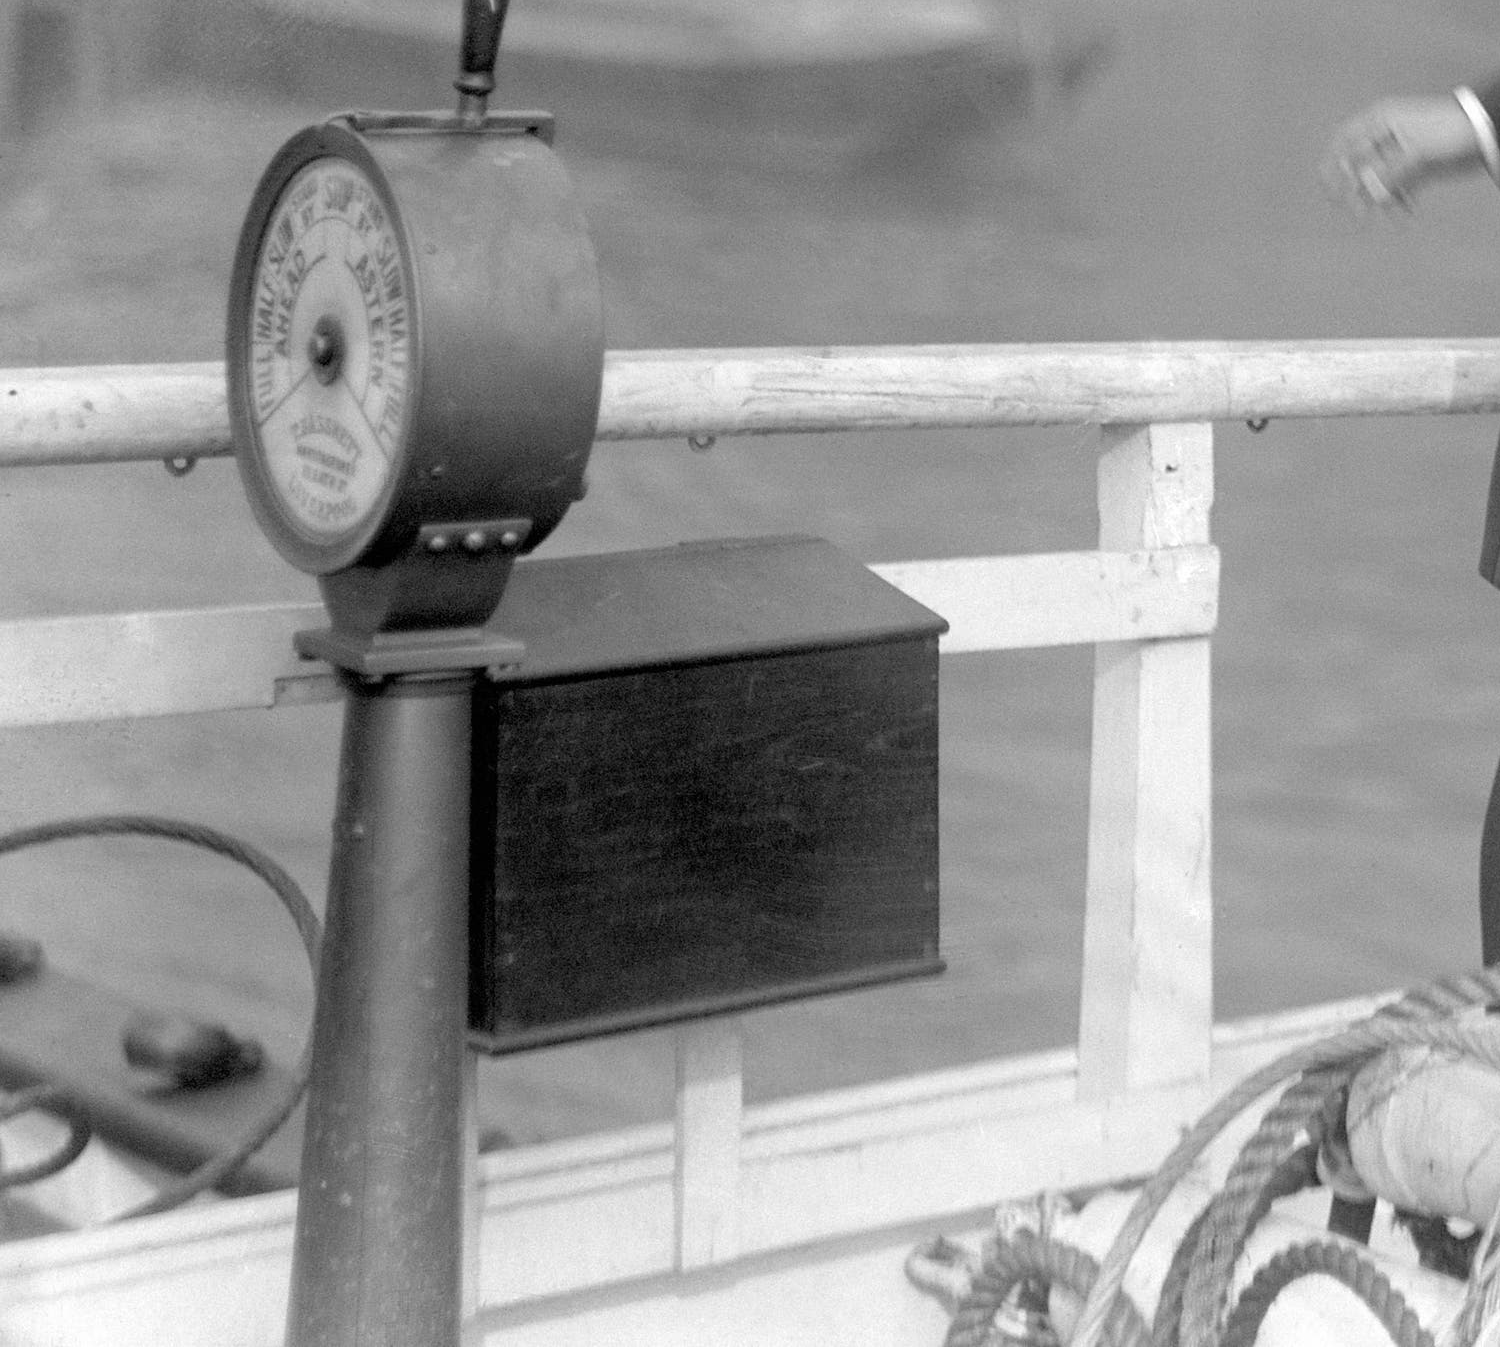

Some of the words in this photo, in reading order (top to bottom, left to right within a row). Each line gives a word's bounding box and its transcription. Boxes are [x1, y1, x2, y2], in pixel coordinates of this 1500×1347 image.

[256, 273, 279, 339] HALF
[274, 250, 306, 357] AHEAD
[355, 253, 385, 388] ASTERN
[255, 351, 275, 414] FULL
